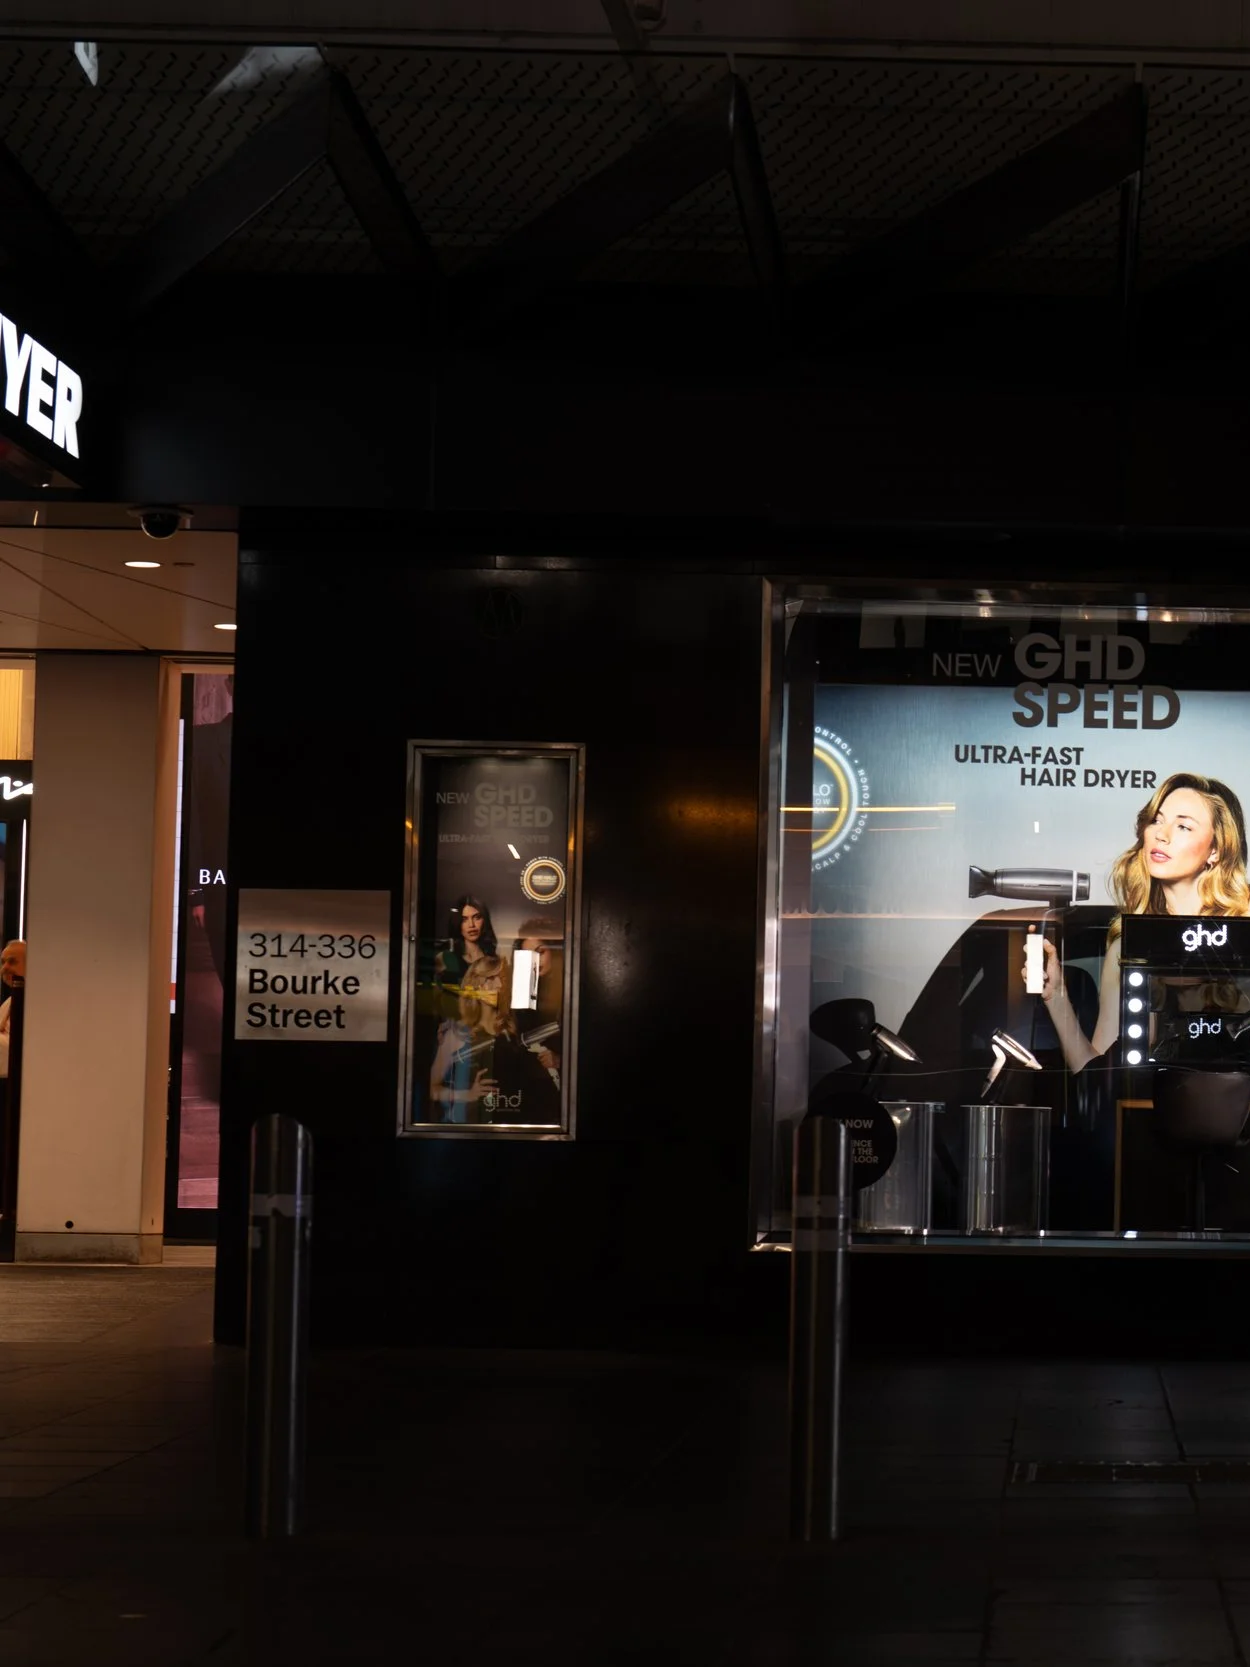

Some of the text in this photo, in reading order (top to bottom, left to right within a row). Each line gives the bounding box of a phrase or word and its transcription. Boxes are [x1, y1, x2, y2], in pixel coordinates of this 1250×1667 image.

[0, 312, 83, 459] YER
[932, 632, 1146, 680] NEW GHD
[1012, 682, 1181, 730] SPEED
[814, 726, 852, 756] ONTROL
[954, 744, 1084, 766] ULTRA-FAST
[858, 769, 870, 806] TOUCH
[1020, 768, 1157, 789] HAIR DRYER
[436, 782, 537, 804] NEW GHD
[474, 805, 553, 828] SPEED
[851, 814, 868, 841] COOL
[812, 852, 841, 871] CALP
[199, 869, 226, 885] BA
[249, 933, 376, 959] 314-336
[1182, 924, 1228, 952] ghd
[249, 969, 360, 995] Bourke
[246, 1002, 346, 1029] Street
[1188, 1018, 1222, 1039] ghd
[483, 1088, 522, 1113] ghd
[845, 1119, 874, 1129] NOW
